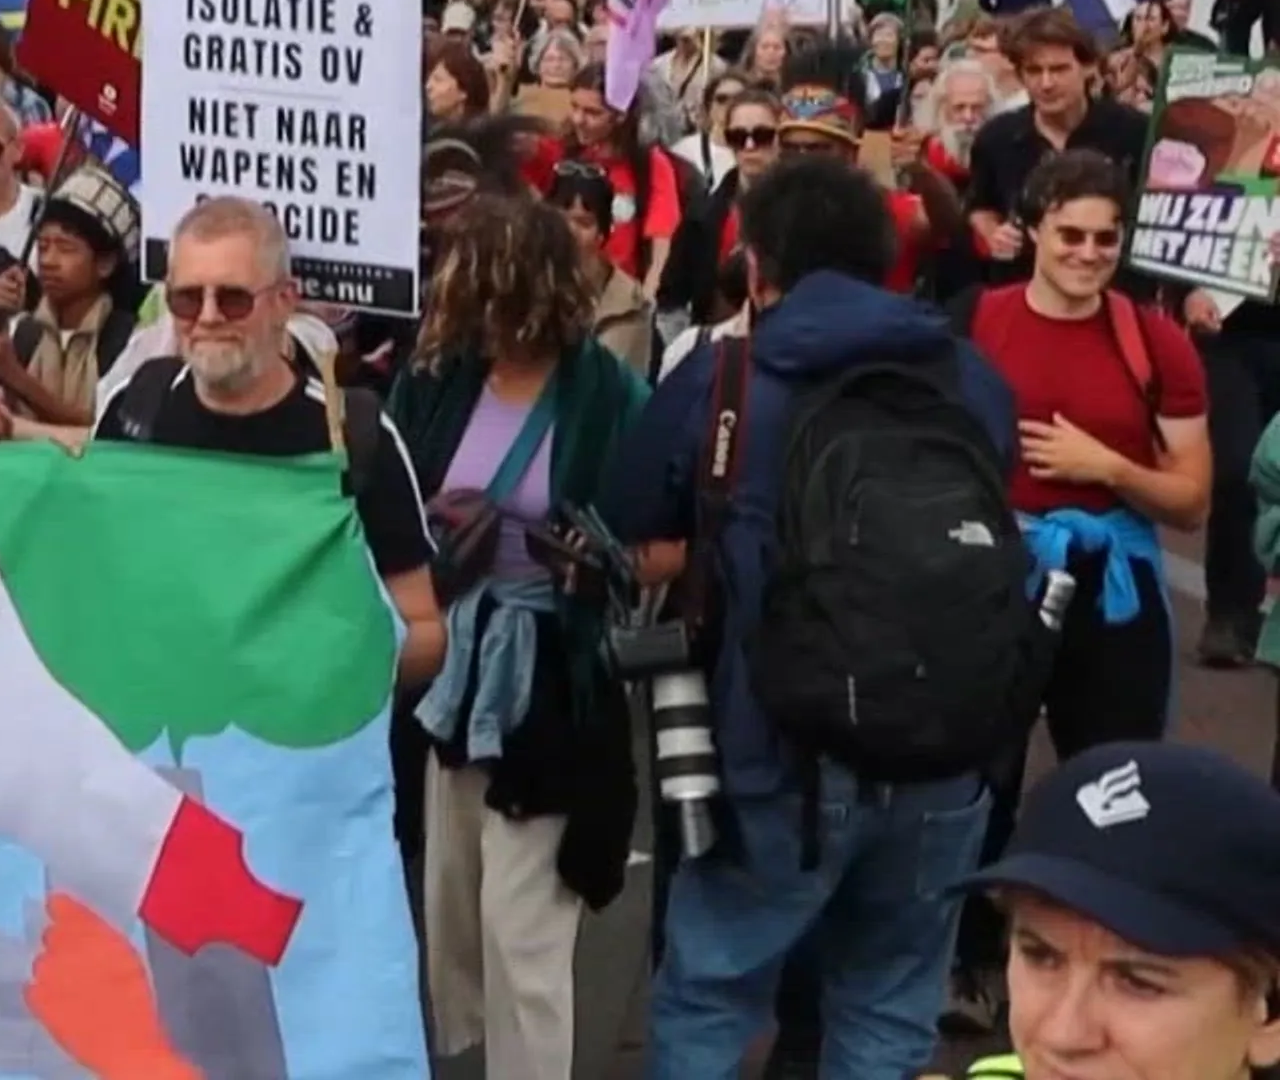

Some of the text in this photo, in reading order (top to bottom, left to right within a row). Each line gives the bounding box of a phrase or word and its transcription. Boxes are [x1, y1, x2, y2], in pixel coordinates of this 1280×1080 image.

[353, 2, 374, 38] &
[183, 32, 364, 87] GRATIS OV
[188, 96, 367, 152] NIET NAAR
[179, 142, 377, 201] WAPENS EN
[195, 193, 361, 247] CIDE
[1137, 192, 1187, 228] WIJ
[1130, 228, 1188, 267] MET
[712, 409, 738, 477] Canon
